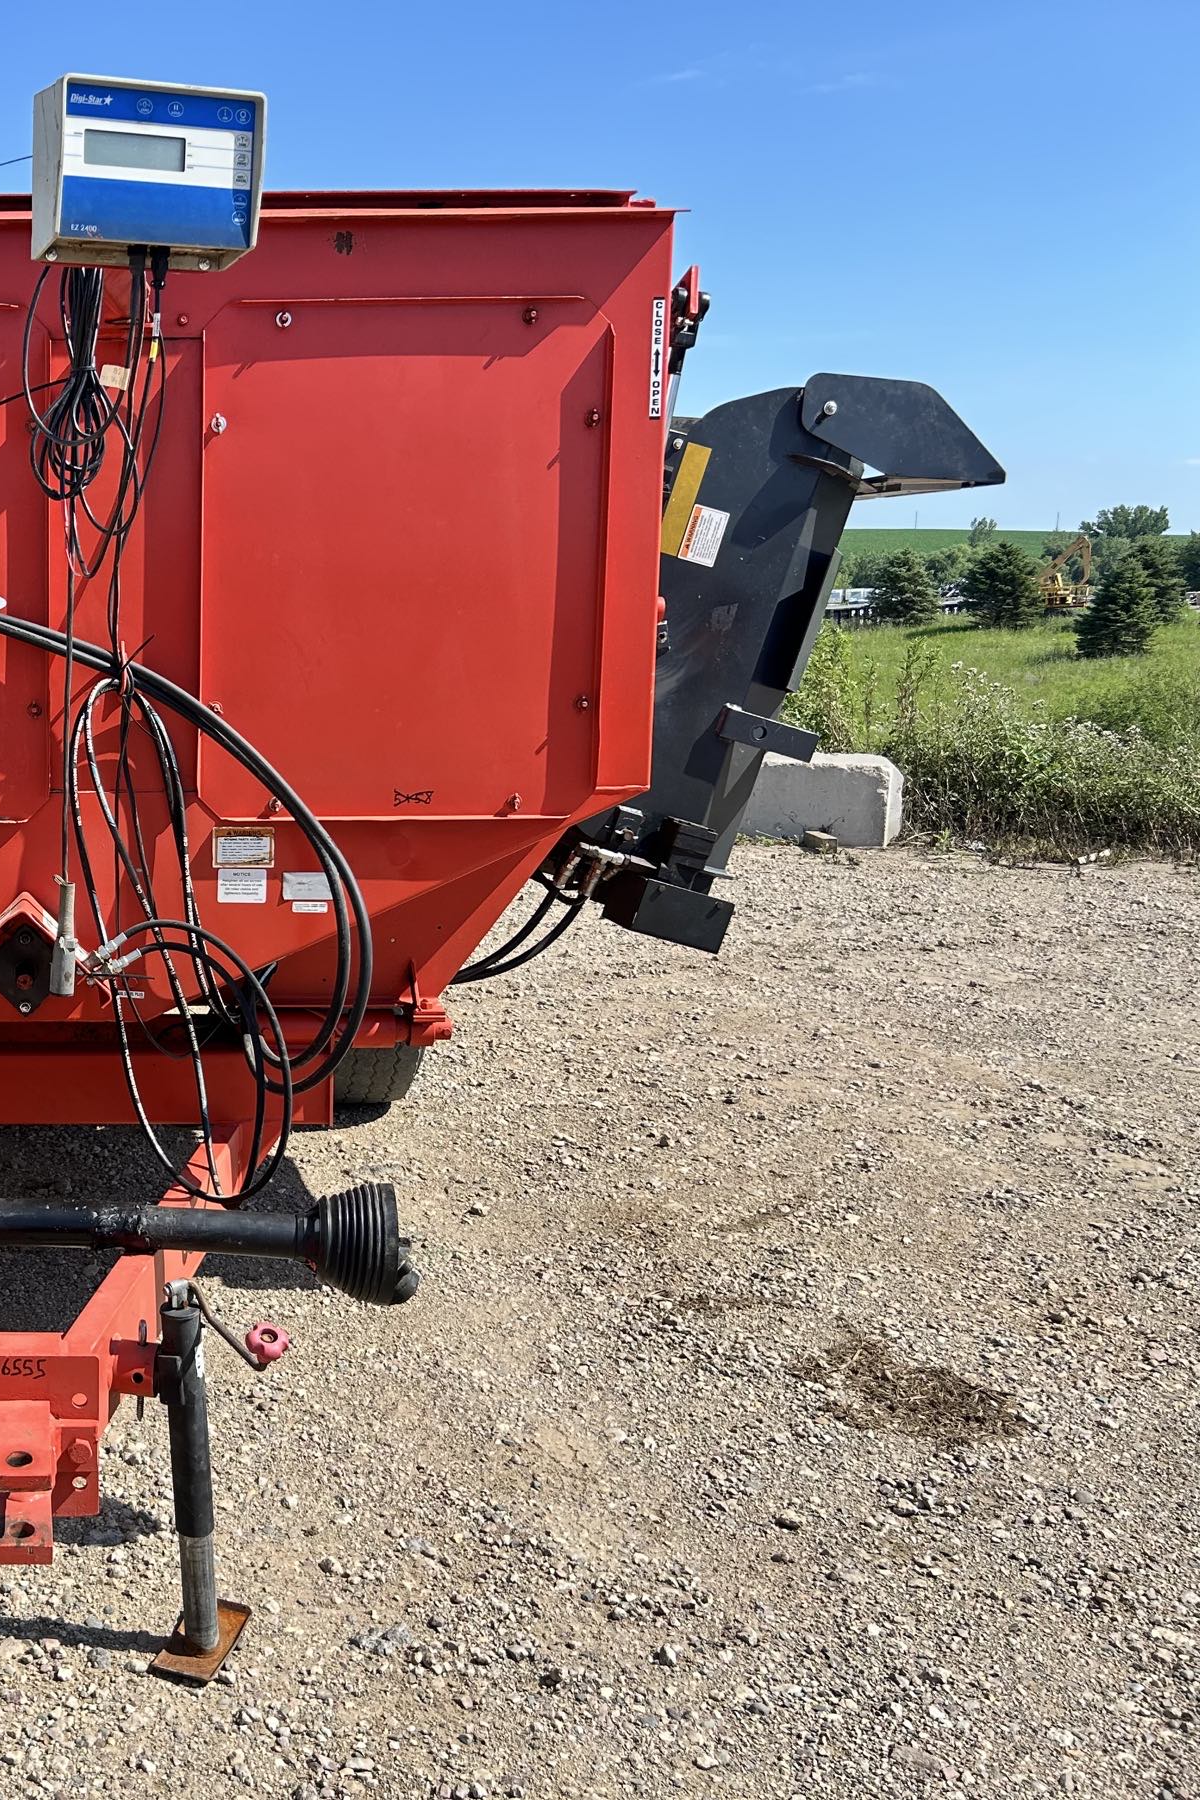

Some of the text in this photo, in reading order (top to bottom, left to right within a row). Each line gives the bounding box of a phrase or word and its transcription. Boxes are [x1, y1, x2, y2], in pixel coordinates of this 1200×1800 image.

[70, 93, 104, 105] Digi-Star
[70, 223, 79, 231] EZ
[654, 301, 663, 345] CLOSE
[651, 381, 660, 415] OPEN
[686, 515, 699, 543] WARNING
[0, 1358, 47, 1379] 6555
